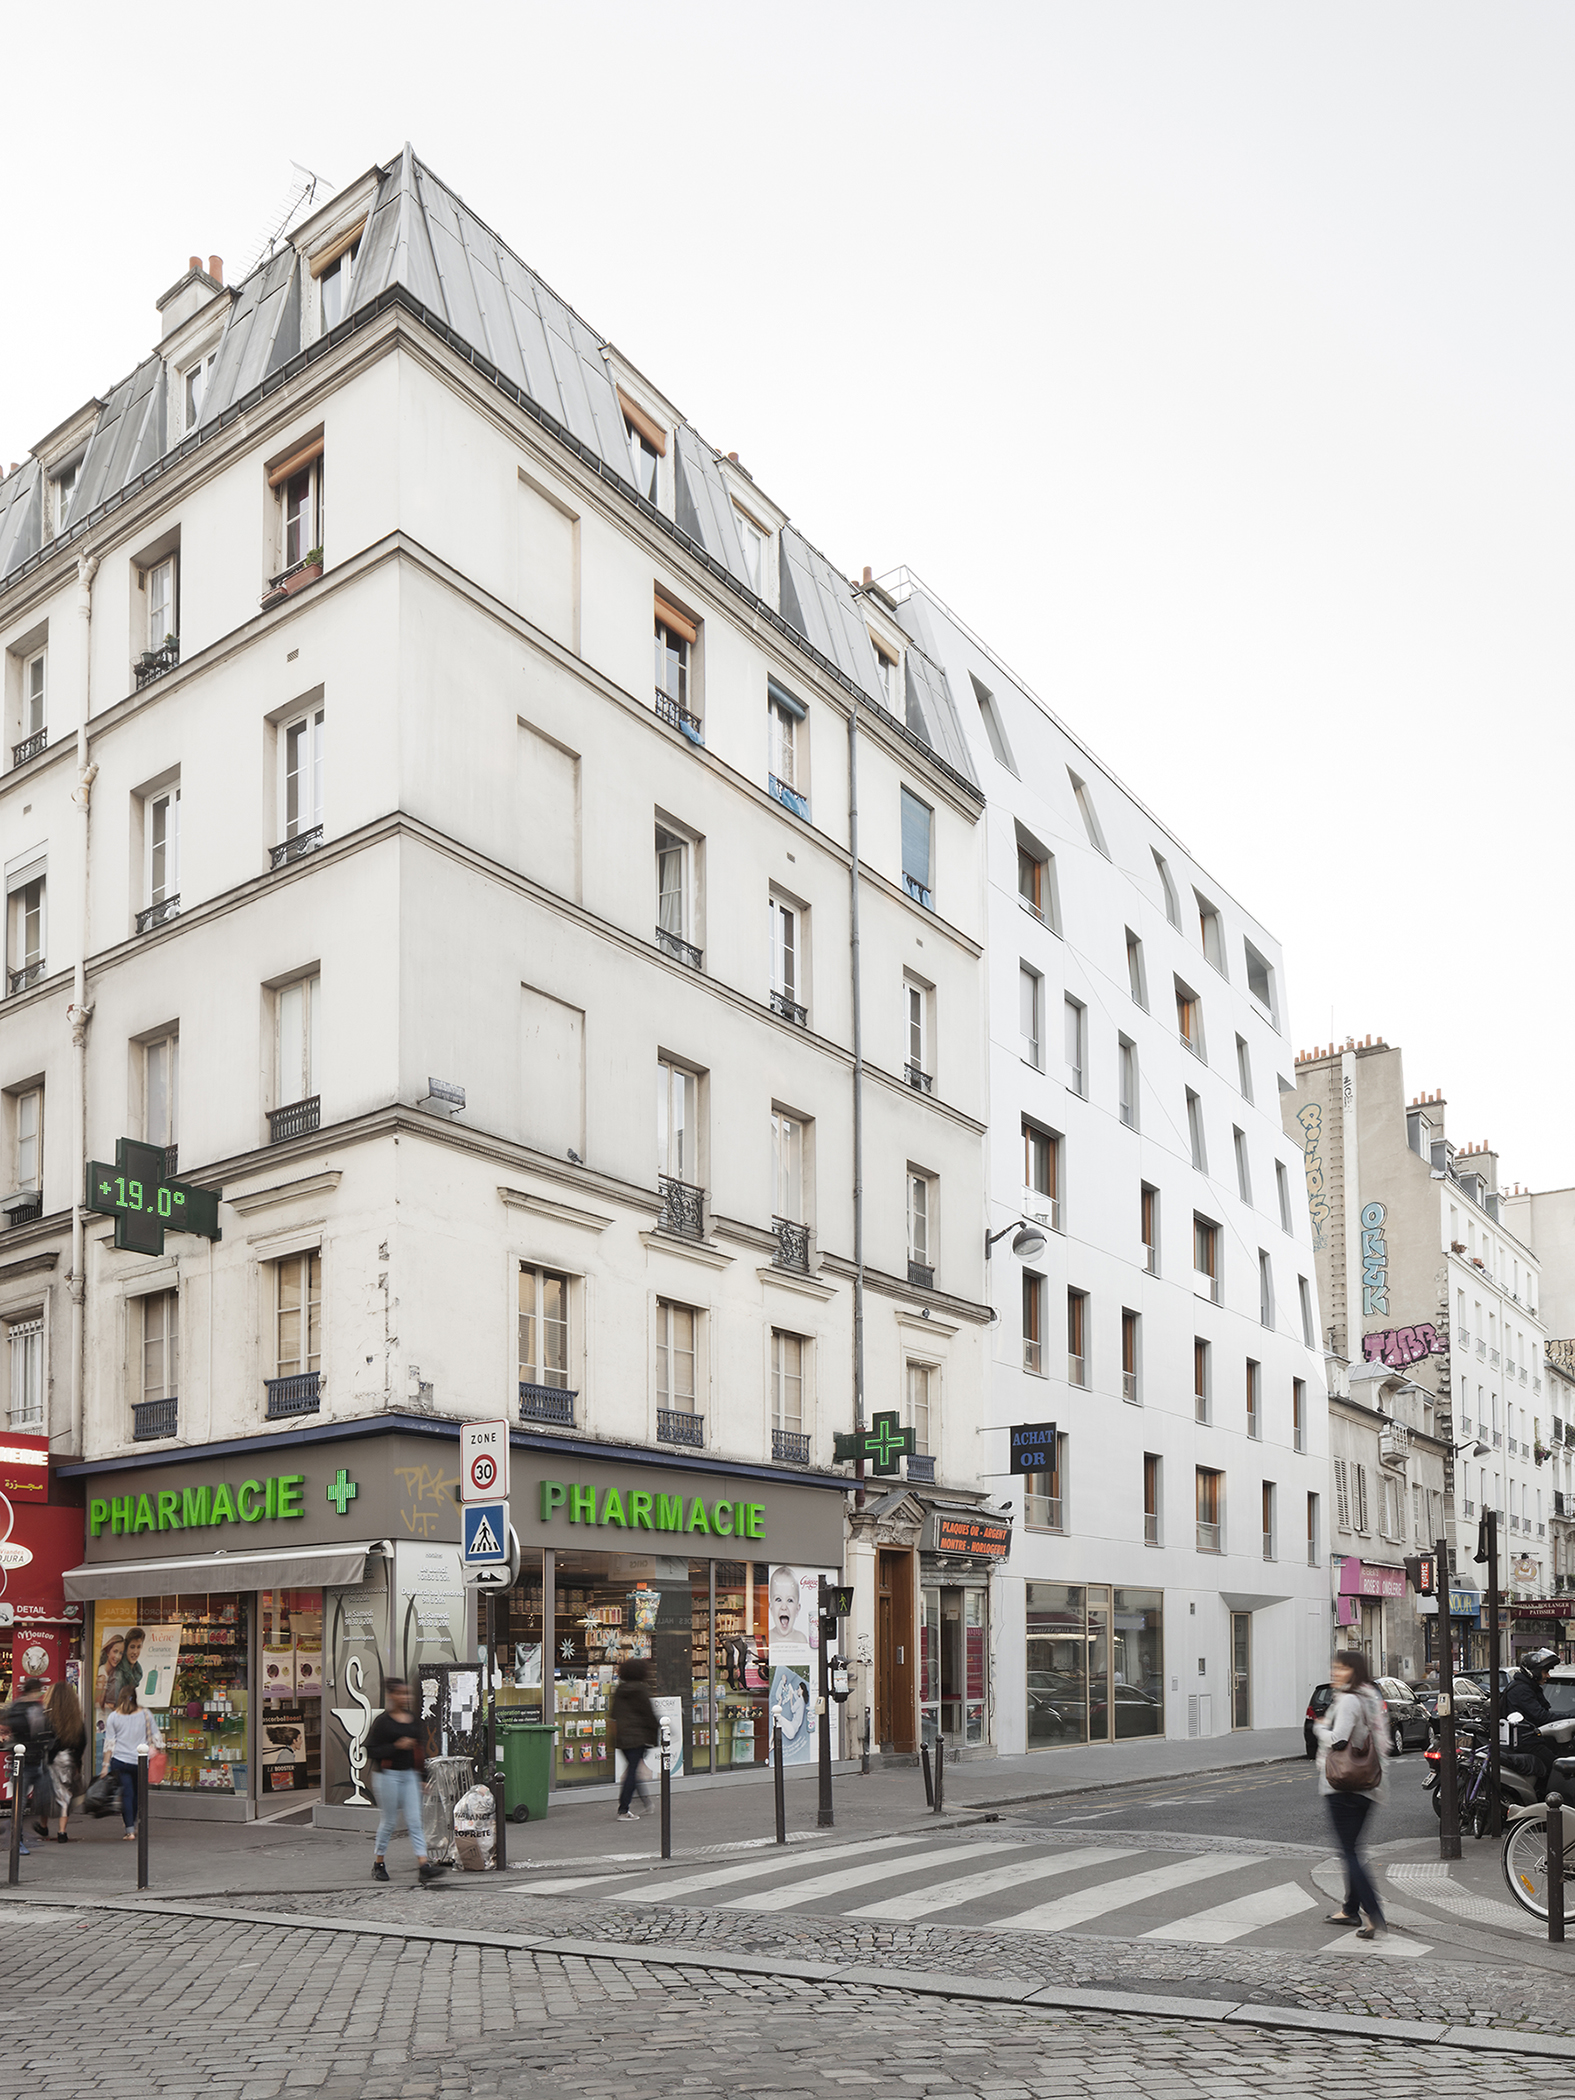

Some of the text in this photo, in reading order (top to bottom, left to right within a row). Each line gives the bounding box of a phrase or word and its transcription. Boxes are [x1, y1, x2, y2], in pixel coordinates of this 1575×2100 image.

[470, 1432, 497, 1445] ZONE
[1012, 1430, 1054, 1446] ACHAT
[1020, 1451, 1046, 1467] OR
[476, 1463, 493, 1480] 30
[90, 1474, 305, 1538] PHARMACIE
[540, 1479, 767, 1540] PHARMACIE
[942, 1521, 970, 1536] PLAQUES
[970, 1525, 980, 1537] OR
[983, 1527, 1007, 1541] ARGENT
[940, 1537, 967, 1551] MONTRE
[971, 1541, 1007, 1555] HORLOGERIE
[17, 1605, 46, 1614] DETAIL
[352, 1609, 374, 1618] Samedi
[417, 1610, 450, 1619] Le Samedi
[17, 1630, 54, 1640] Mouton
